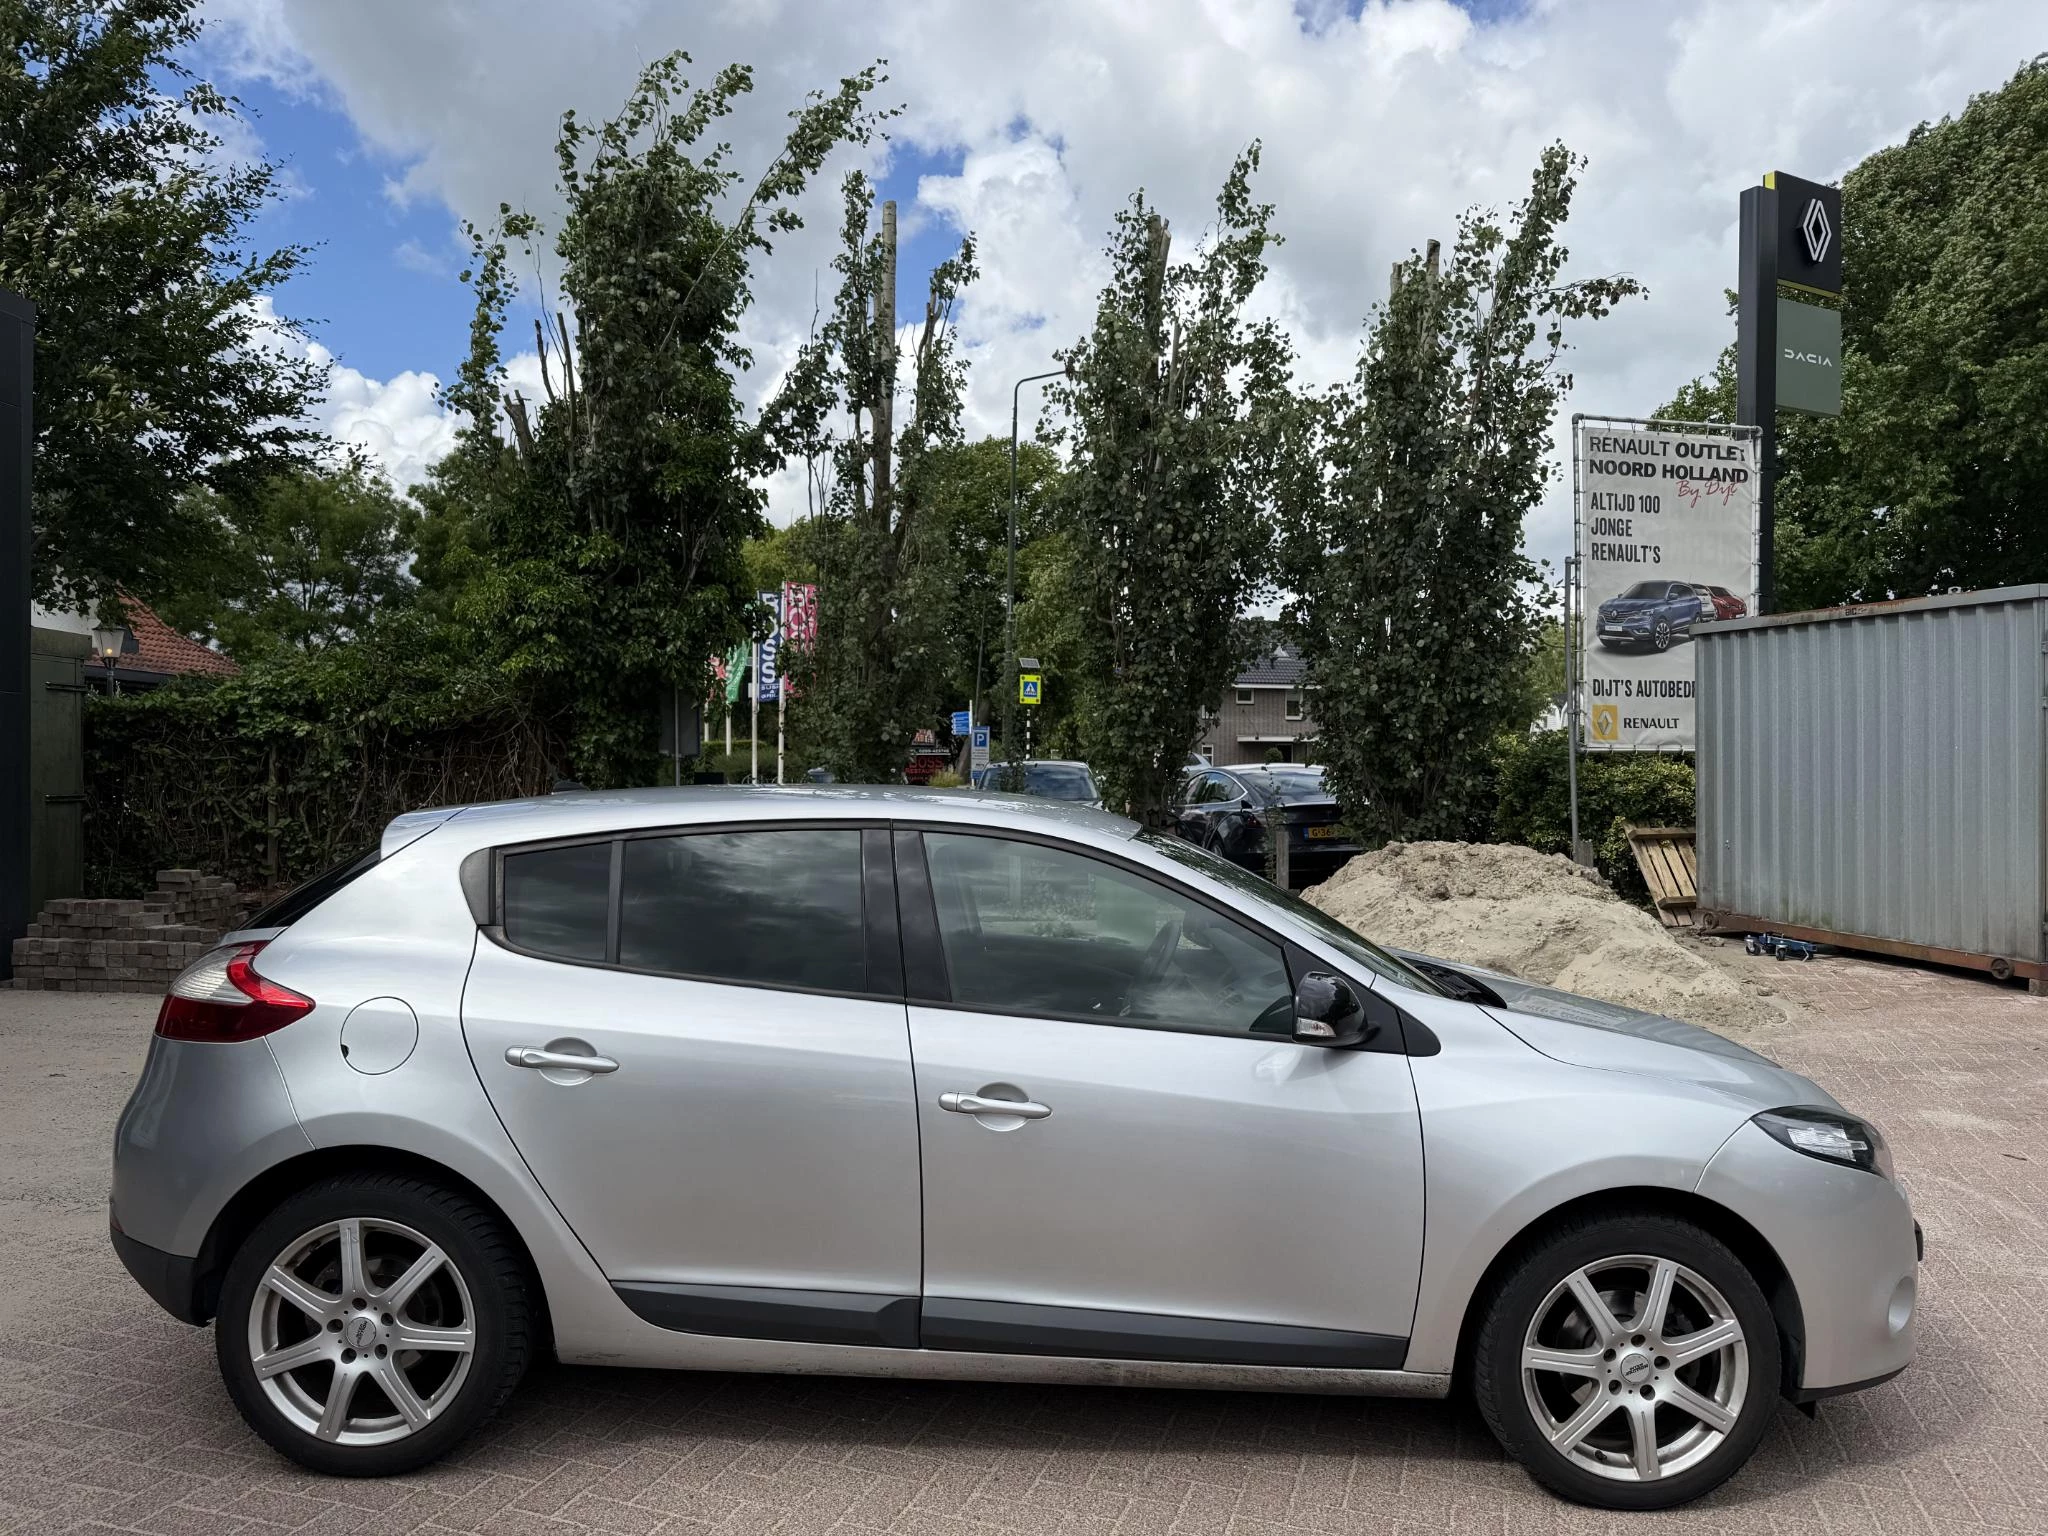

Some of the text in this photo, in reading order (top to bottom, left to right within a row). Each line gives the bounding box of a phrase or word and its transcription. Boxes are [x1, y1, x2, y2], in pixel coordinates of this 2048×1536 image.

[1784, 348, 1832, 367] DACIA
[1589, 436, 1670, 456] RENAULT
[1589, 459, 1748, 484] NOORD HOLLAND
[1590, 492, 1660, 514] ALTIJD 100
[1590, 517, 1633, 537] JONGE
[1591, 542, 1661, 564] RENAULT'S
[1592, 679, 1633, 697] DIJT'S
[1623, 717, 1680, 729] RENAULT
[976, 733, 985, 746] P
